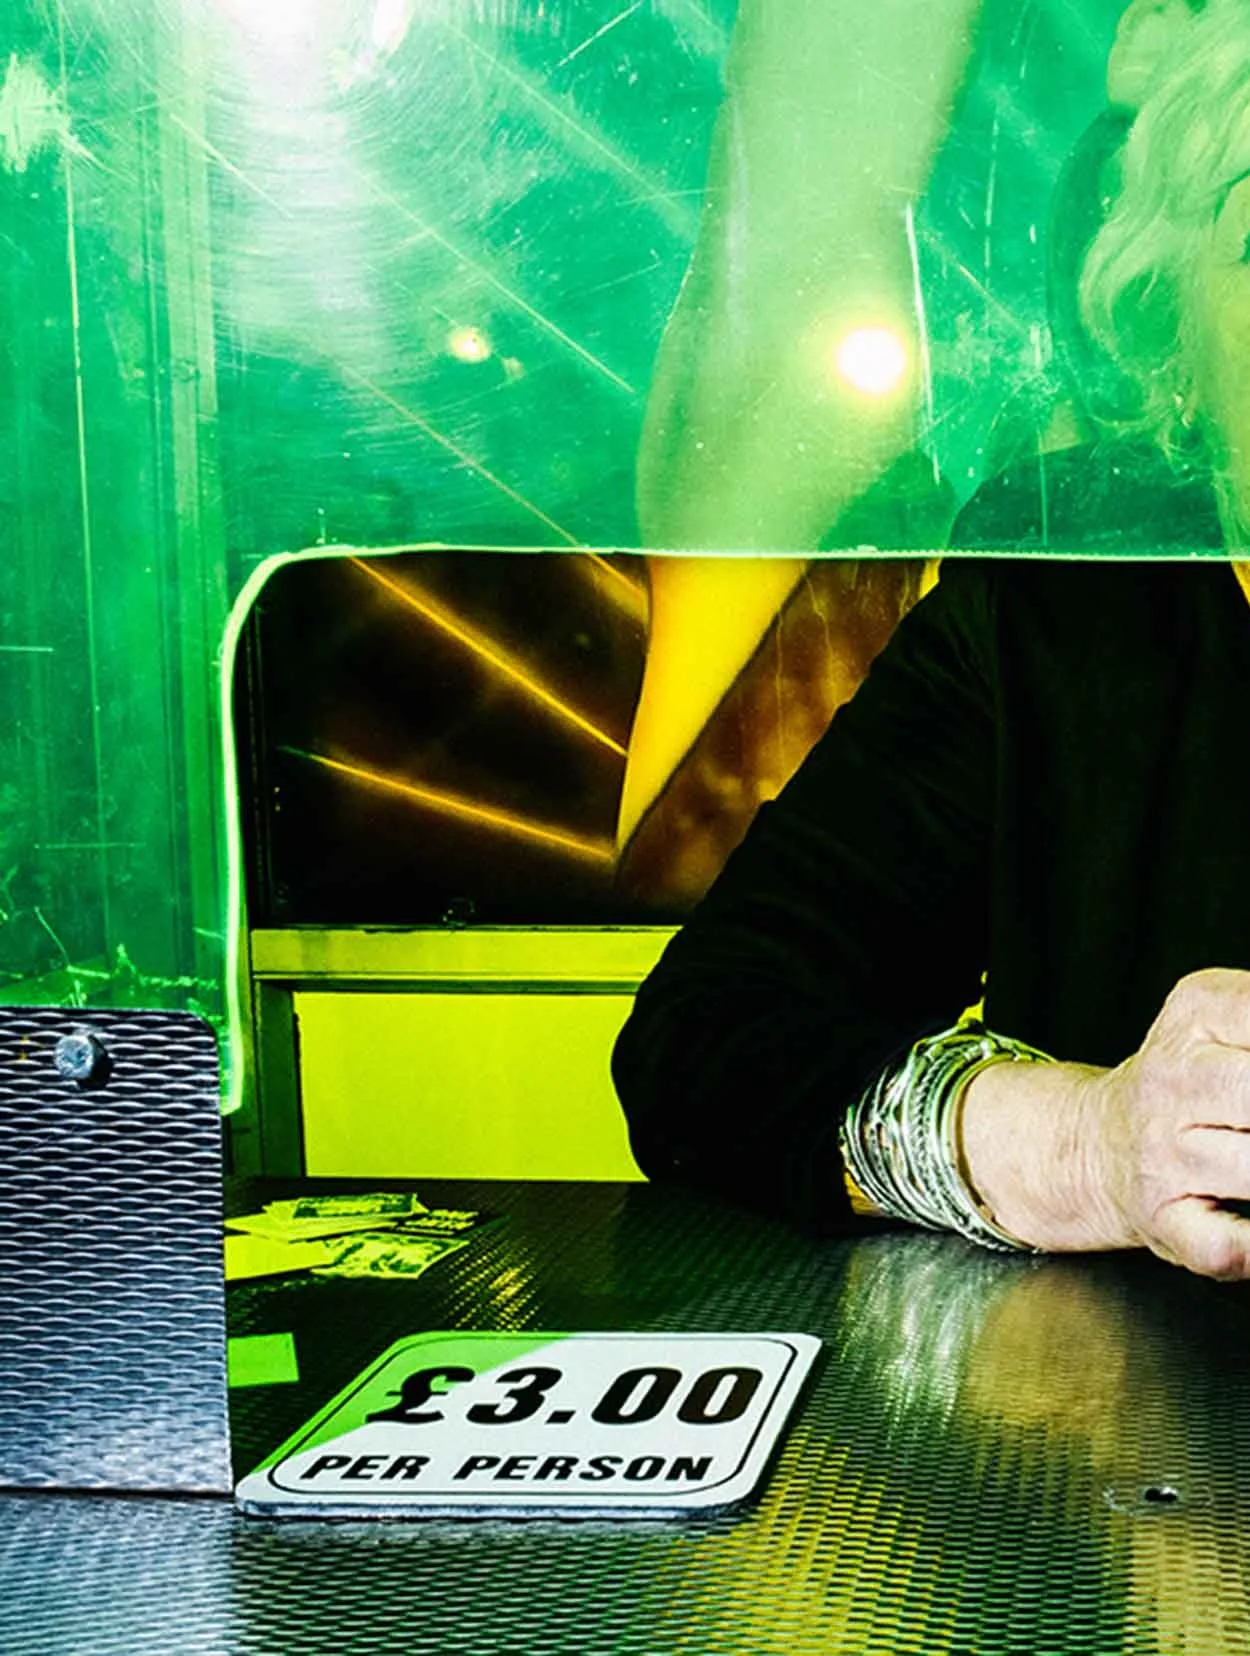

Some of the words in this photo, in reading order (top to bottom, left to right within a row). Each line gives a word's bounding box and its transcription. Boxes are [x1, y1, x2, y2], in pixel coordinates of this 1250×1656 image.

[365, 1366, 763, 1425] £3.00
[299, 1455, 430, 1481] PER
[453, 1455, 713, 1481] PERSON
